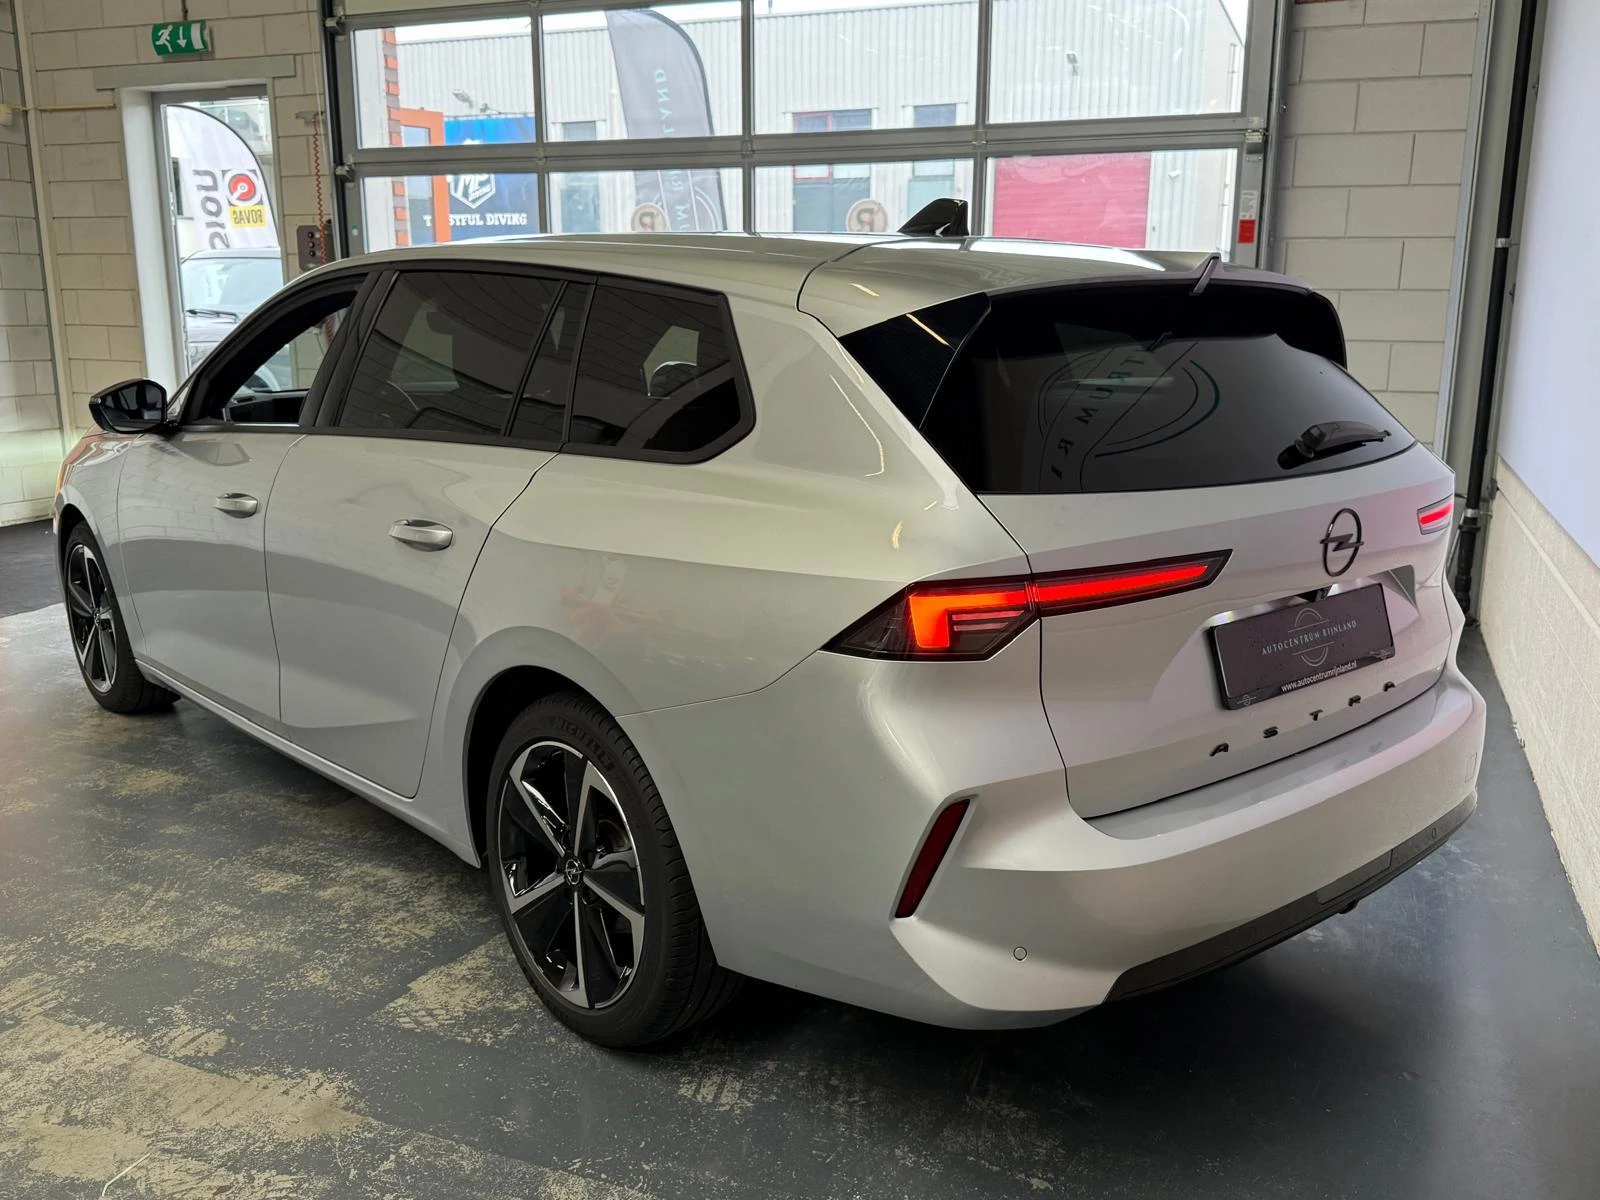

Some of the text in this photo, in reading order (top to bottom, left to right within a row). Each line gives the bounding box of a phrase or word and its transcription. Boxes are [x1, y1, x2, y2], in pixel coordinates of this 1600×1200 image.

[423, 212, 527, 226] TSTFUL DIVING
[1262, 619, 1357, 656] AUTOCENTRUM RIJNLAND
[1281, 660, 1358, 693] www.autocentrumrijnland.nl
[1209, 681, 1396, 757] ASTRA
